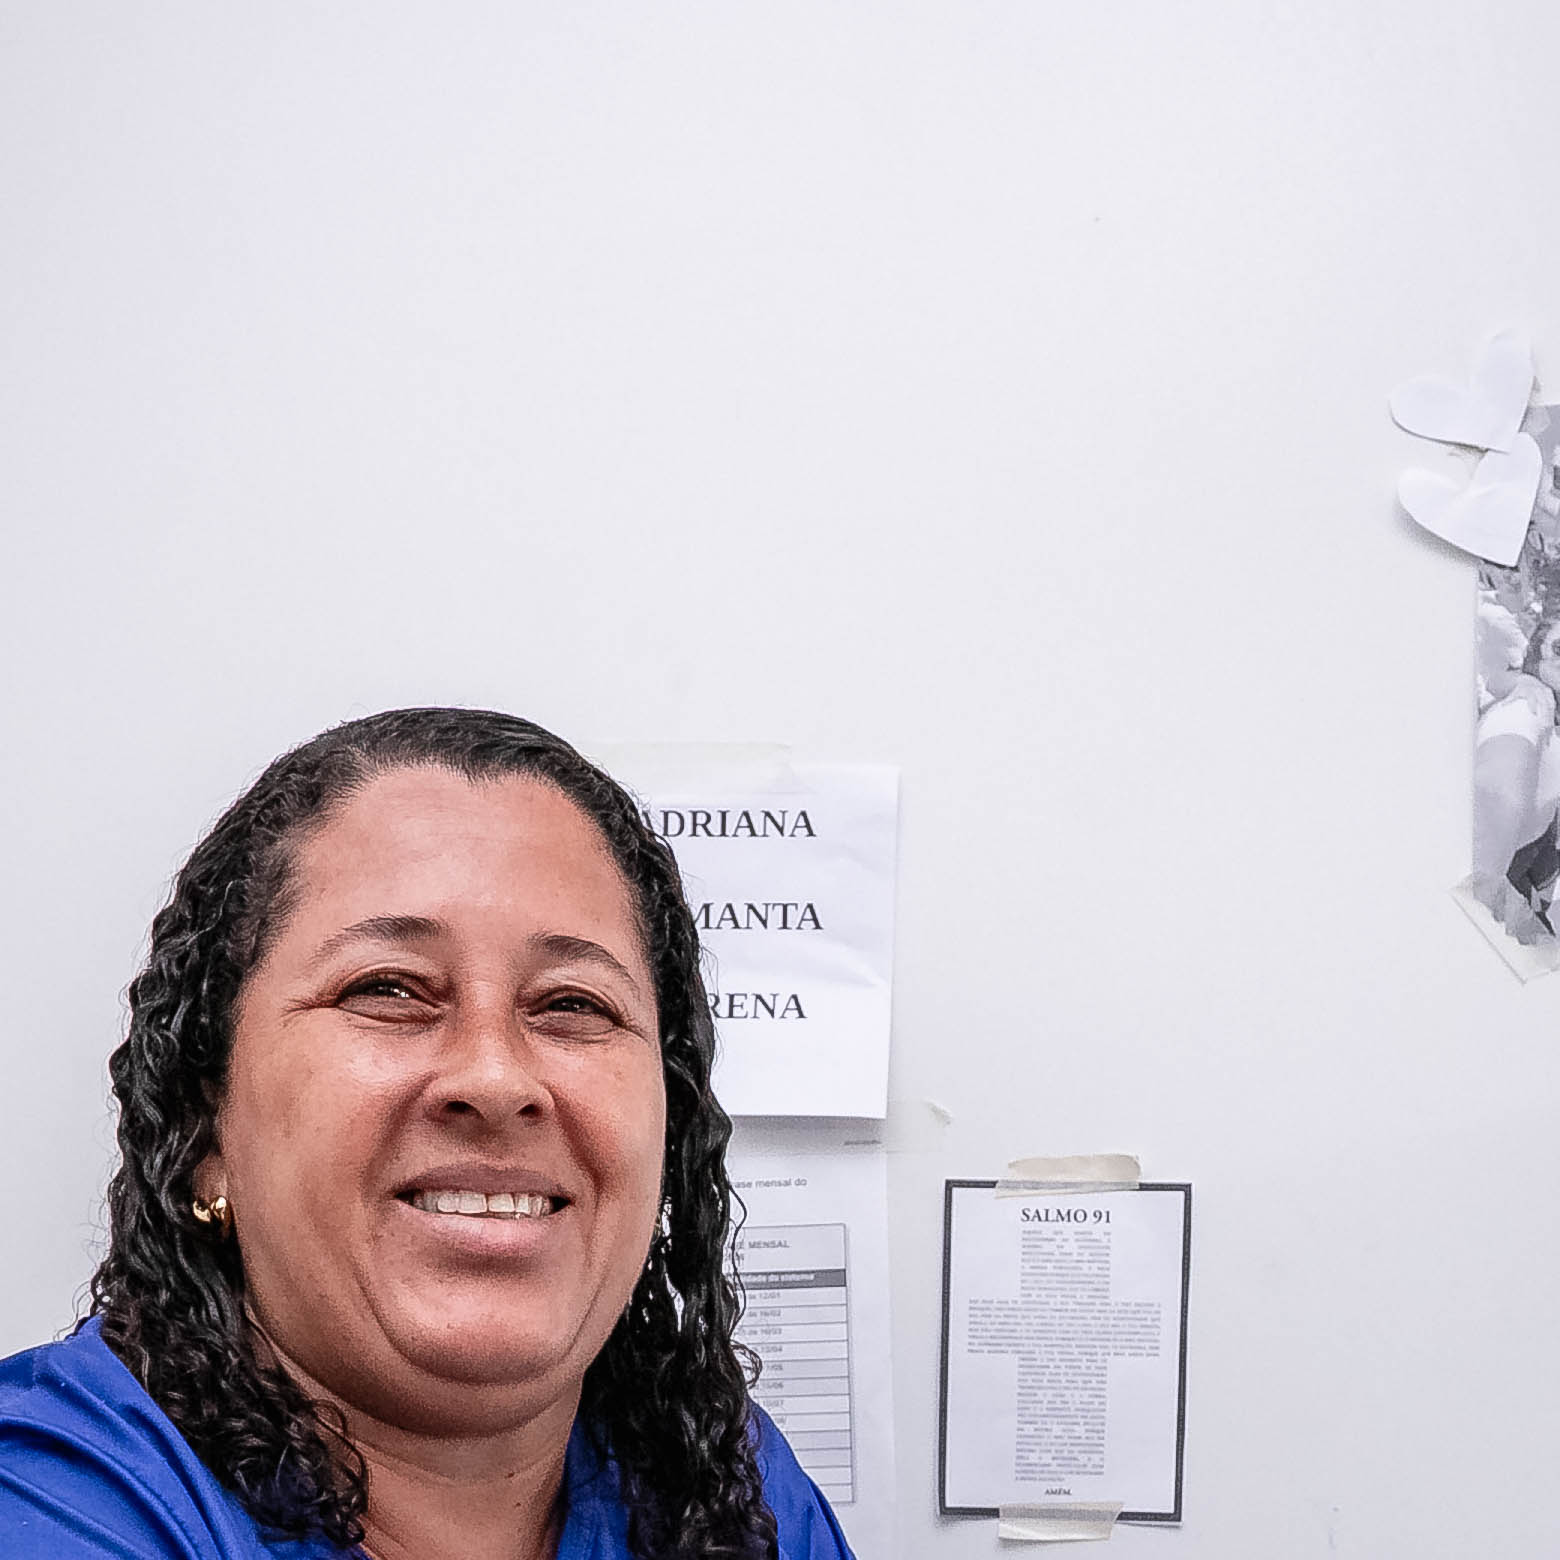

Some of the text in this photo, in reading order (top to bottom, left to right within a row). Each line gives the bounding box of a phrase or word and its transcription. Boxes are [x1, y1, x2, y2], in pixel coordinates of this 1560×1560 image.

[794, 1178, 808, 1187] do
[1021, 1208, 1111, 1224] SALMO 91
